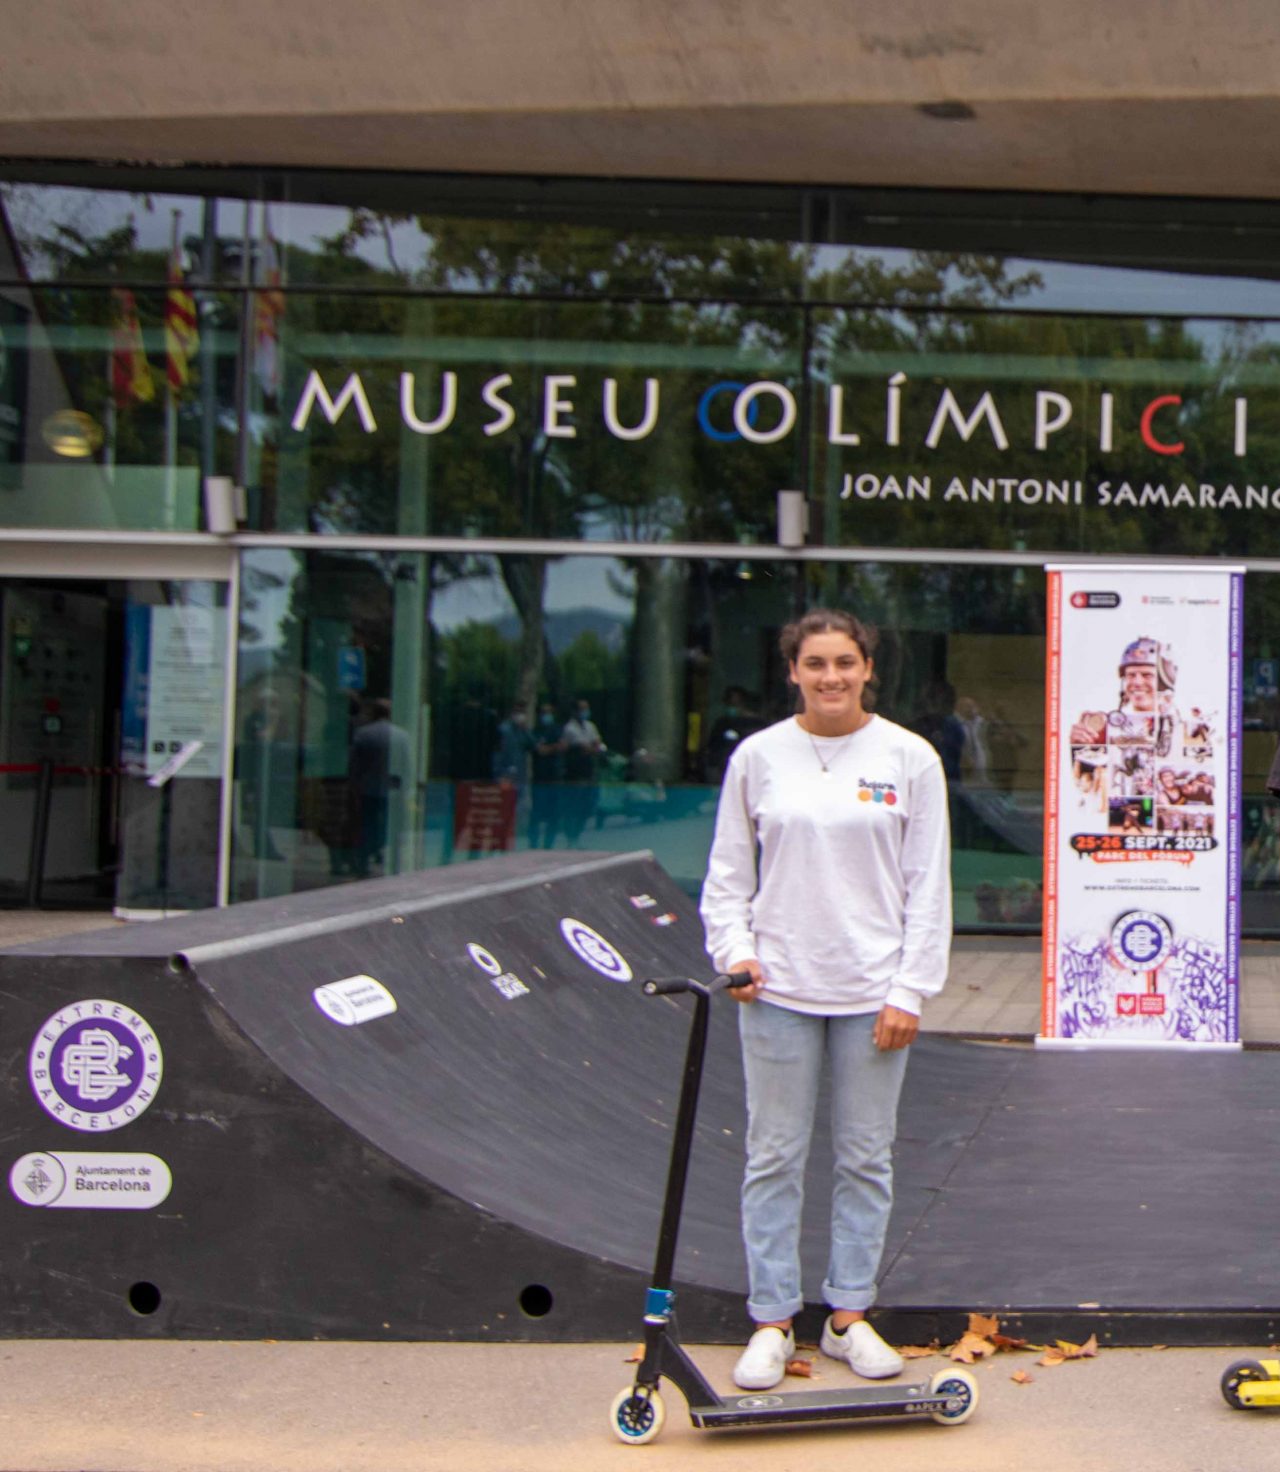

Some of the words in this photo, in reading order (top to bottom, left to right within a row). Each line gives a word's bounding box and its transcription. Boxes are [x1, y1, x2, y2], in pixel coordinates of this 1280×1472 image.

[291, 369, 659, 442] MUSEU
[731, 372, 1186, 456] OLÍMPIC
[1234, 397, 1247, 458] I
[840, 473, 931, 500] JOAN
[943, 478, 1083, 505] ANTONI
[1075, 836, 1122, 849] 25-26
[1124, 836, 1172, 850] SEPT.
[1174, 837, 1212, 850] 2021
[43, 1003, 154, 1044] EXTREME
[35, 1070, 159, 1129] BARCELONA
[75, 1178, 151, 1192] Barcelona
[76, 1166, 136, 1177] Ajuntament
[138, 1166, 152, 1175] de
